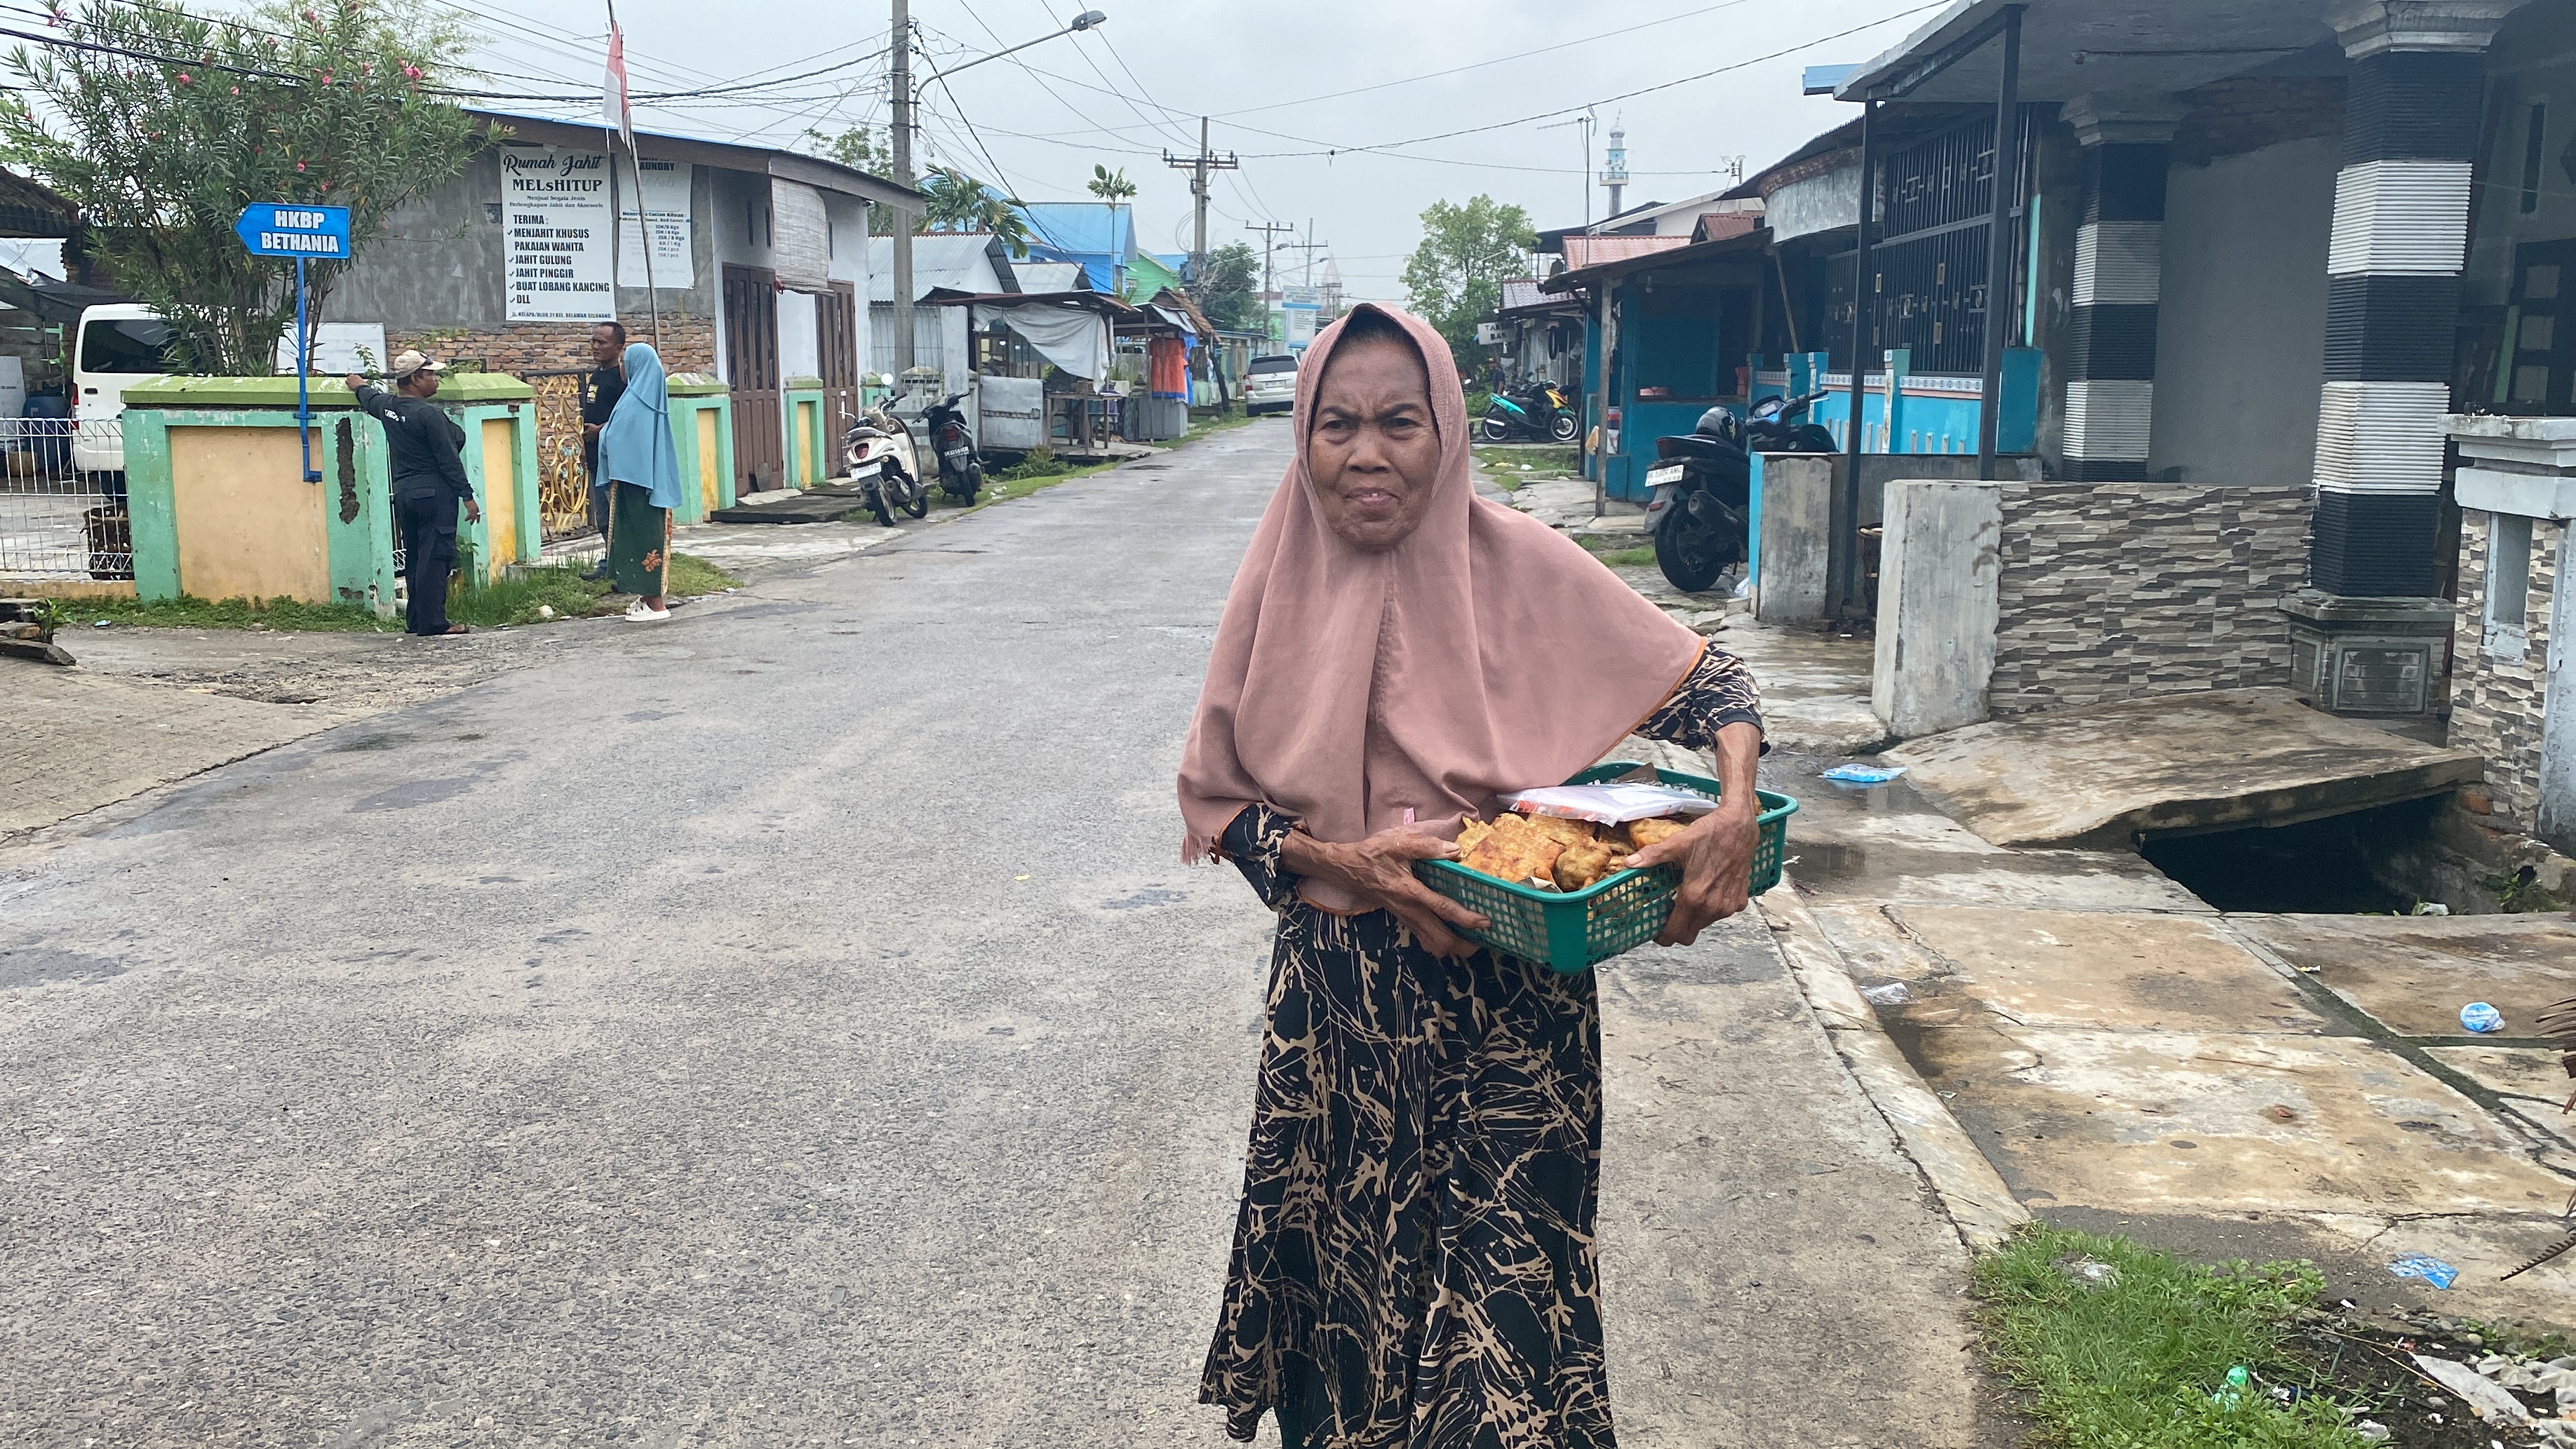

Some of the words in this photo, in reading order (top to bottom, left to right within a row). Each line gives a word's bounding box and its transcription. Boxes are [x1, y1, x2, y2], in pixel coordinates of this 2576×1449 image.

[504, 154, 557, 176] Rumah
[561, 154, 605, 176] Jahit
[639, 162, 675, 170] AUNDRY
[274, 210, 325, 229] HKBP
[514, 215, 544, 224] TERIMA
[514, 229, 554, 238] MENJAHIT
[556, 229, 589, 238] KHUSUS
[260, 232, 340, 252] BETHANIA
[515, 241, 549, 251] PAKAIAN
[551, 242, 584, 251] WANITA
[515, 255, 537, 264] JAHIT
[539, 255, 572, 264] GULUNG
[516, 268, 537, 278] JAHIT
[539, 269, 574, 278] PINGGIR
[516, 281, 537, 290] BUAT
[539, 282, 570, 291] LOBANG
[572, 283, 610, 292] KANCING
[517, 295, 530, 304] DLL
